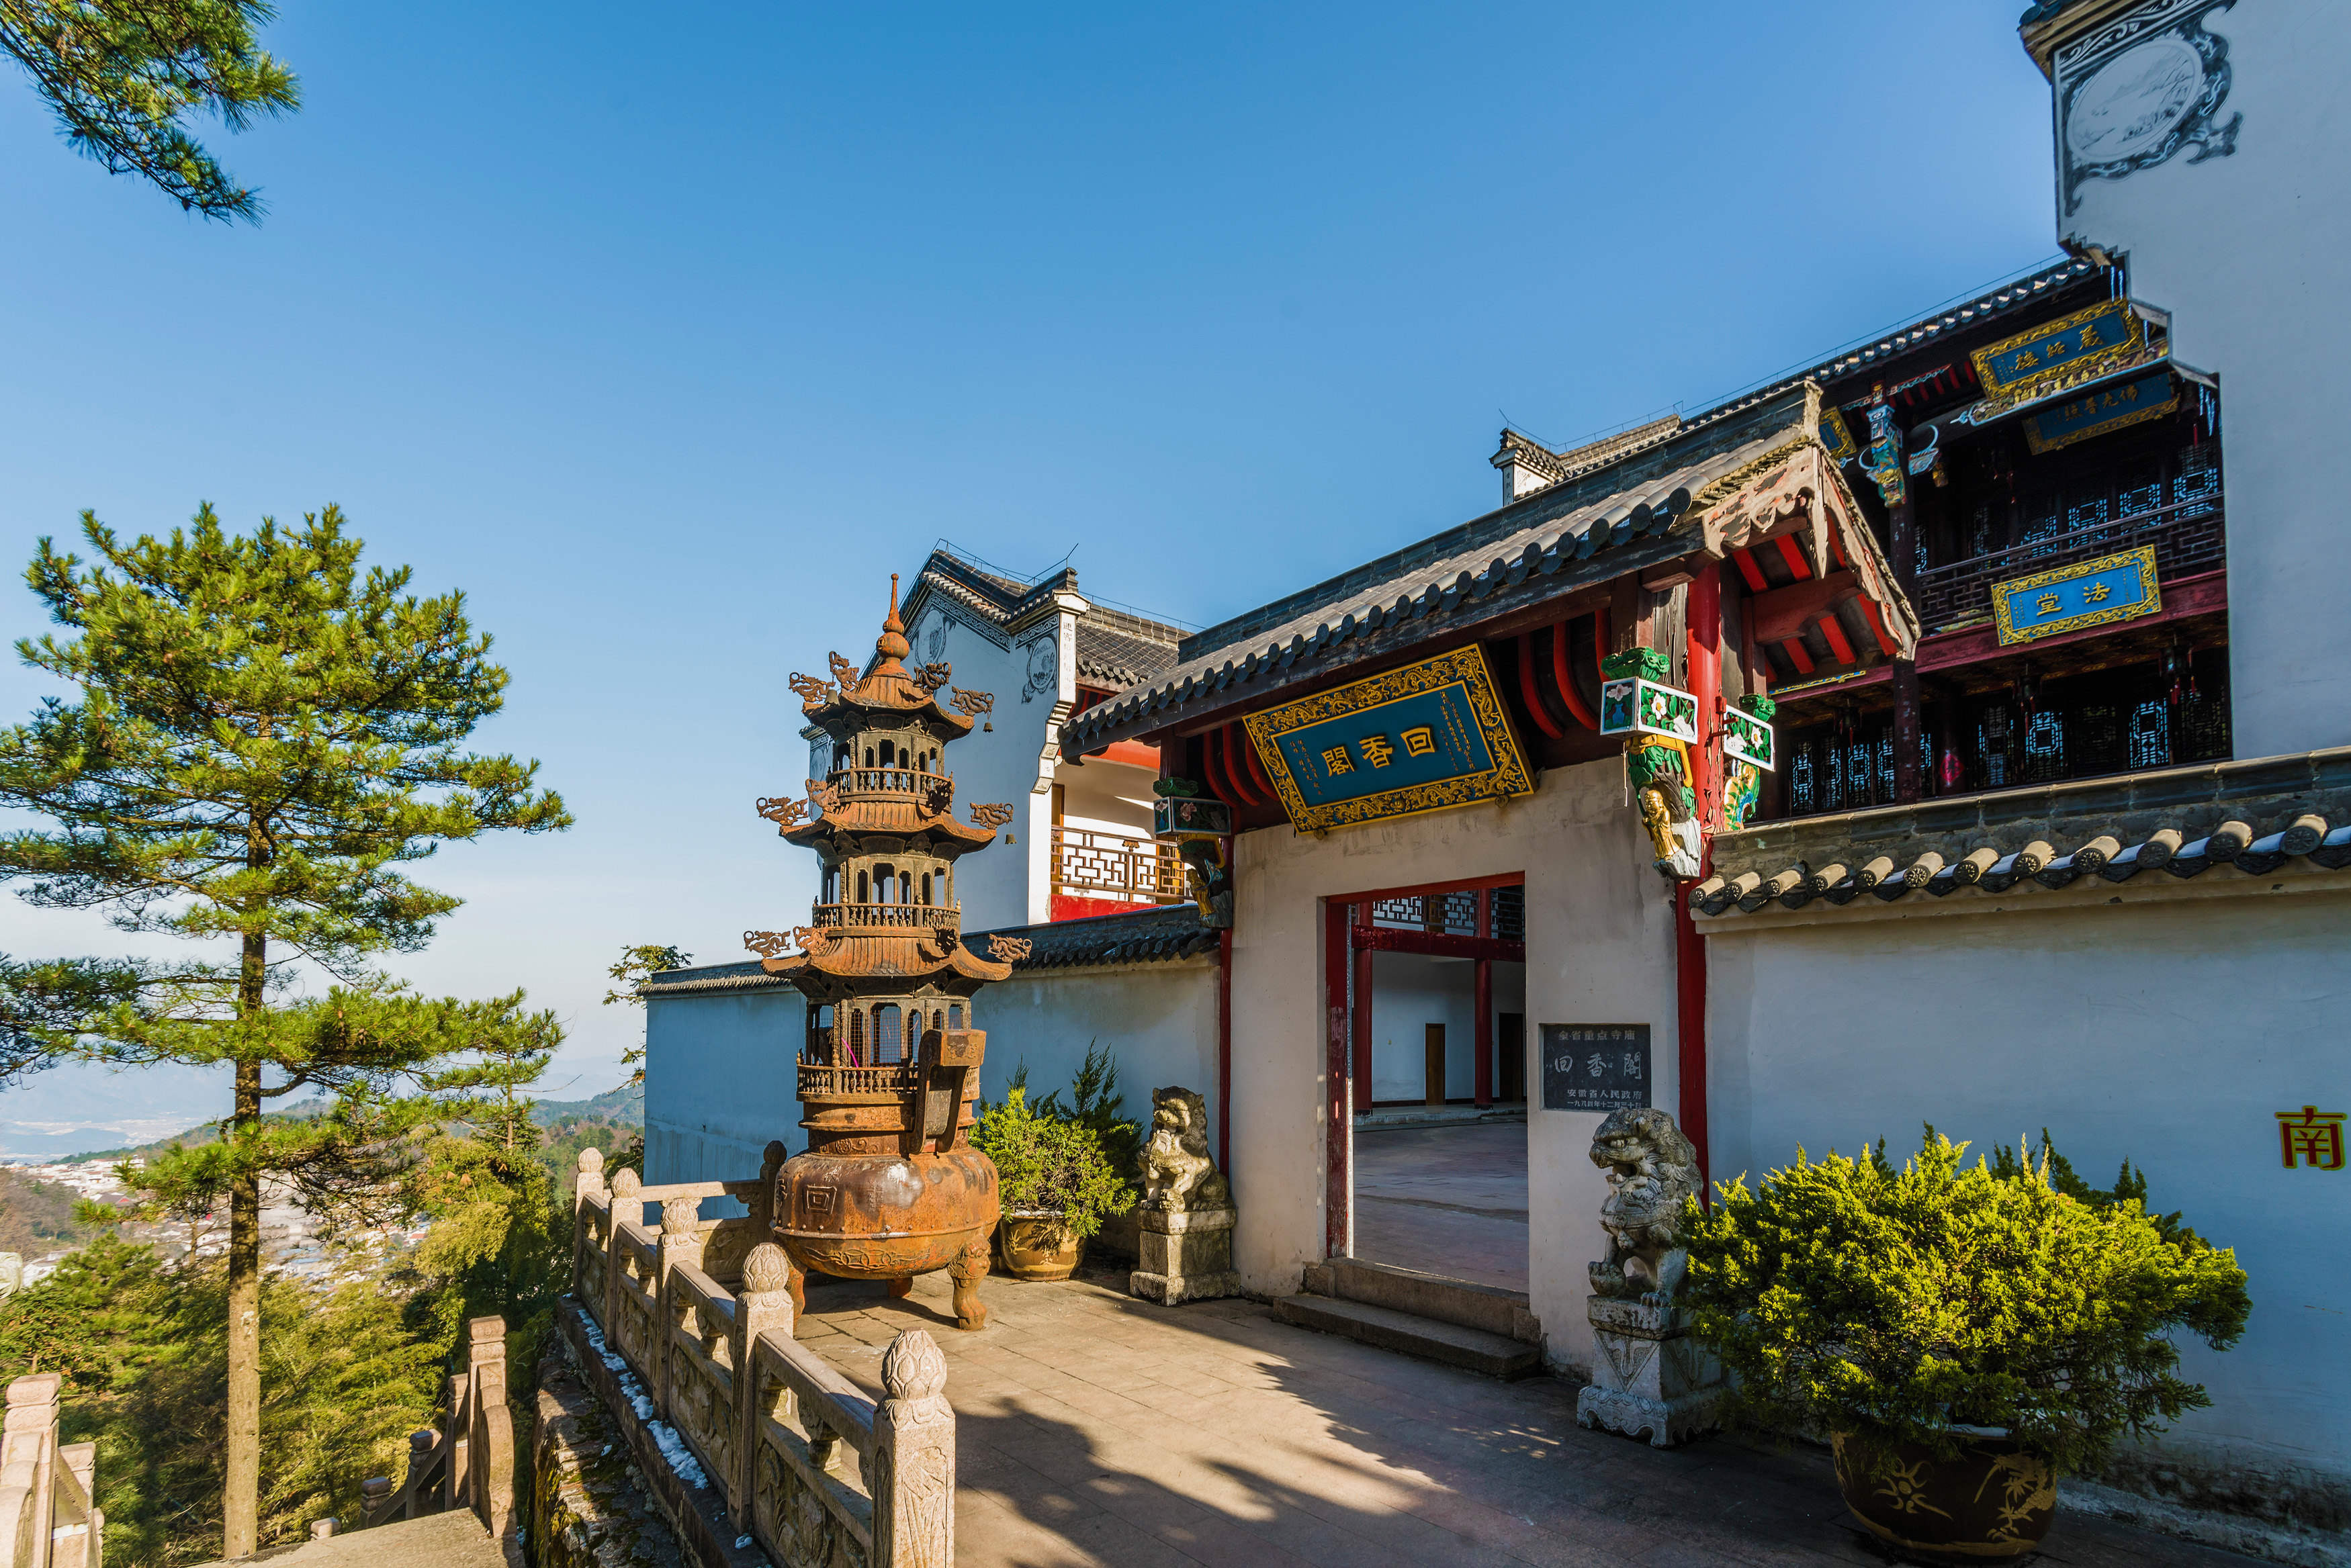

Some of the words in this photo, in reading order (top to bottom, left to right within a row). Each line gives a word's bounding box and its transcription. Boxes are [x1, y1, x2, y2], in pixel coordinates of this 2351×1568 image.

[2036, 582, 2111, 616] 法堂
[1321, 727, 1437, 777] 回香閣
[1558, 1029, 1635, 1041] 全省重点寺庙
[1567, 1089, 1642, 1100] 安徽省人民政府
[2274, 1105, 2348, 1170] 南
